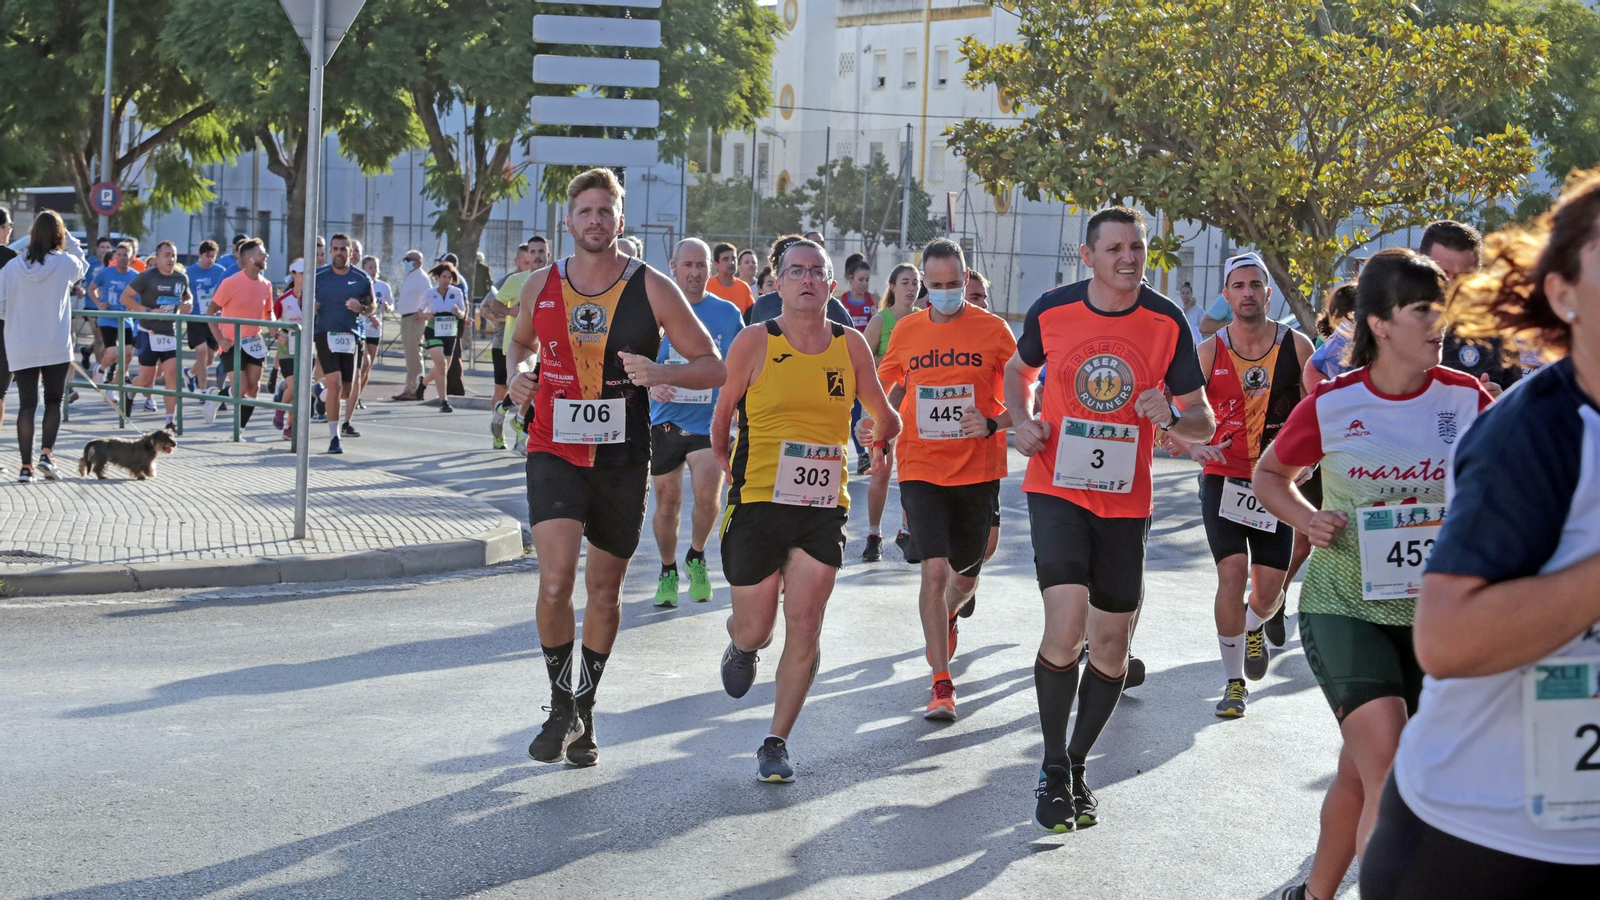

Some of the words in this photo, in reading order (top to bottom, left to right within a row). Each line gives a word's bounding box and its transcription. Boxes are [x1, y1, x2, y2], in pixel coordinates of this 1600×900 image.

[156, 337, 171, 345] 974
[909, 348, 983, 370] adidas
[1084, 358, 1118, 373] BEER
[1080, 385, 1132, 410] RUNNERS
[569, 403, 611, 423] 706
[929, 406, 963, 422] 445
[1068, 420, 1085, 429] XLI
[1090, 448, 1105, 469] 3
[793, 466, 830, 487] 303
[1348, 457, 1446, 481] marató
[1380, 486, 1431, 494] JEREZ
[1367, 511, 1388, 520] XLI
[1575, 723, 1600, 771] 2
